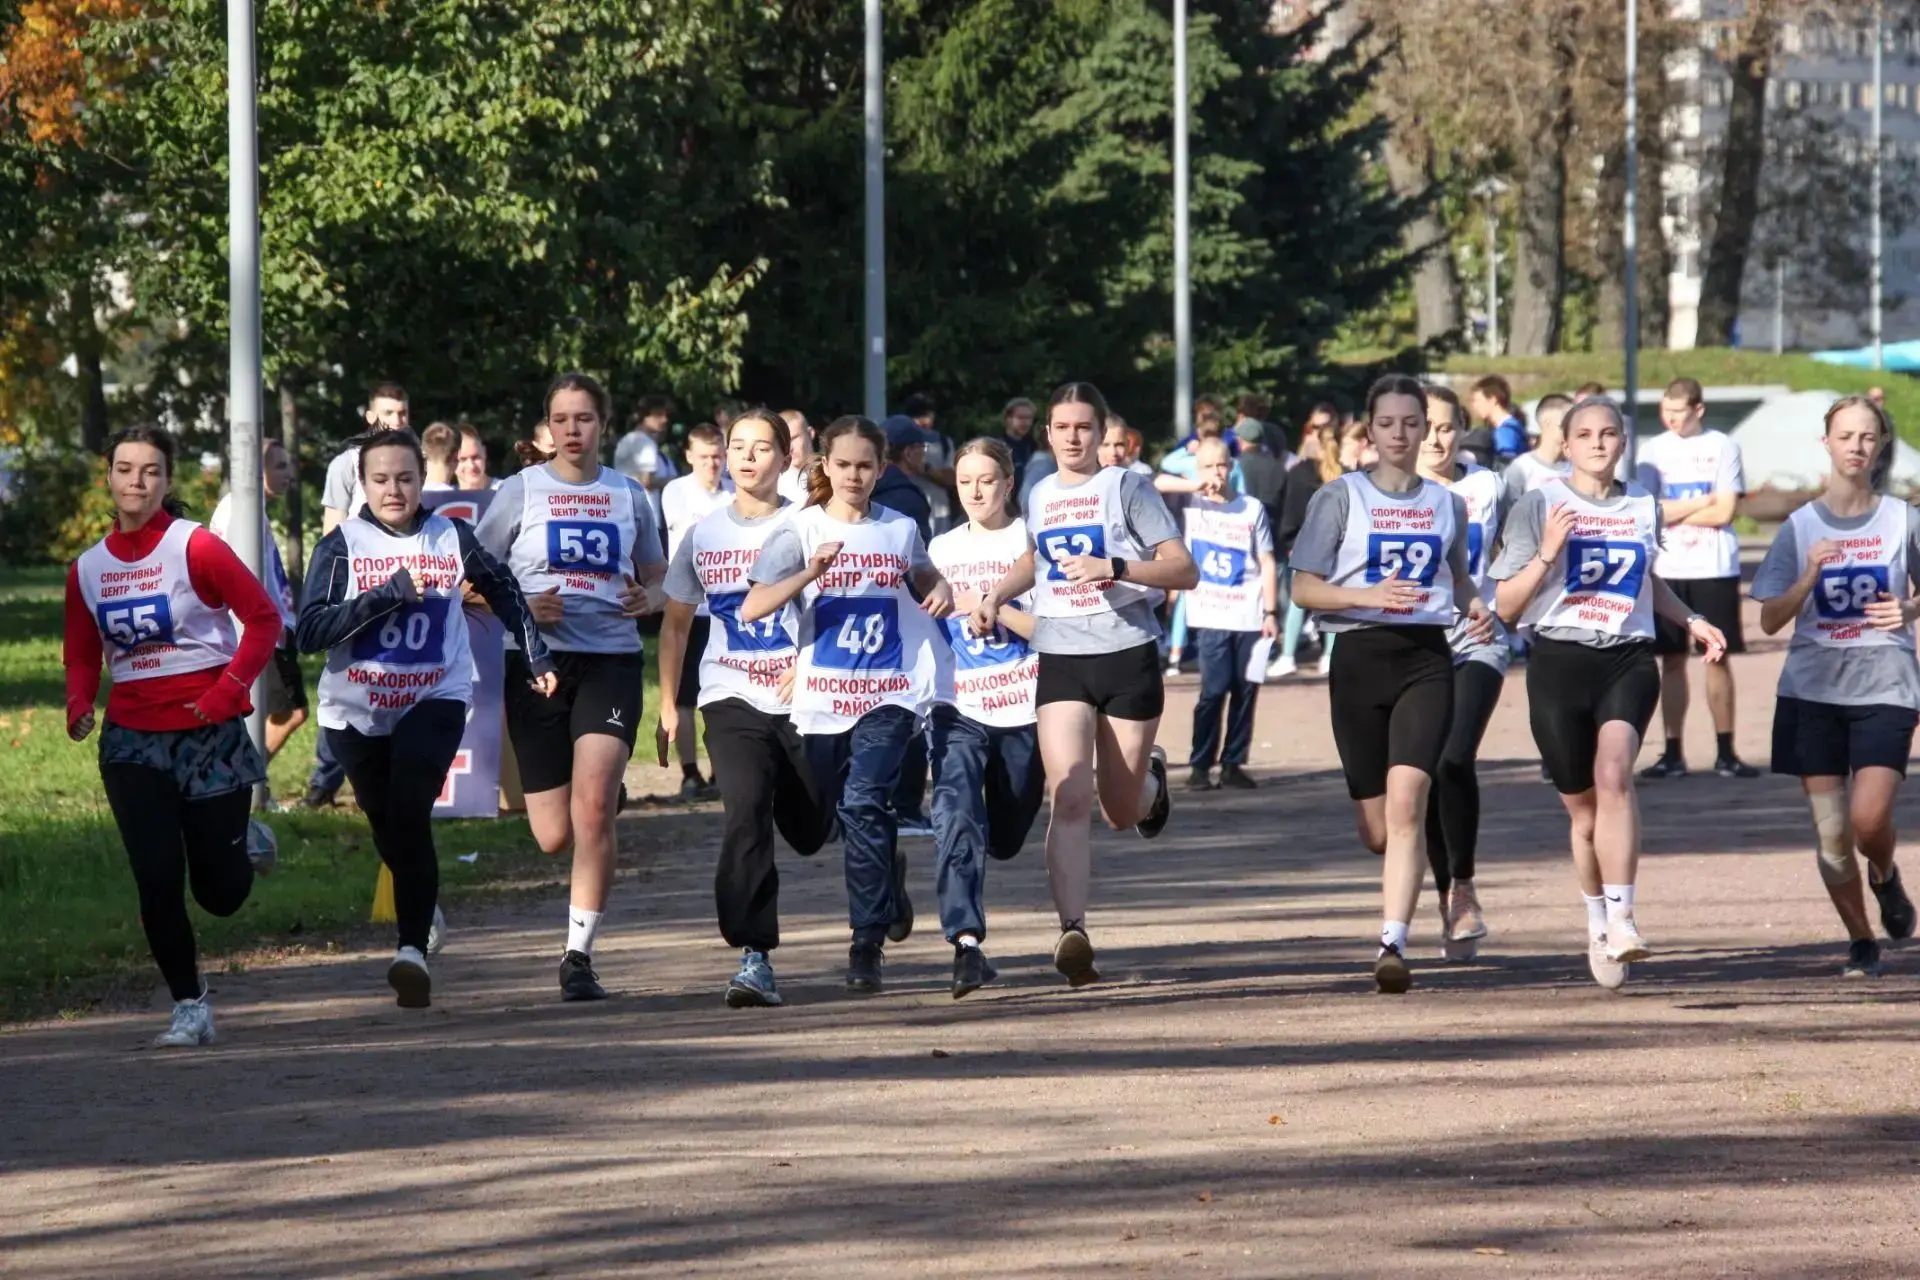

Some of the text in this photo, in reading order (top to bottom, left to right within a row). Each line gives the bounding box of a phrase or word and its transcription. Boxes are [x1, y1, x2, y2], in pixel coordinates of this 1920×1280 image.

[548, 493, 611, 506] СПОРТИВНЫЙ
[1045, 494, 1100, 513] СПОРТИВНЫЙ
[551, 508, 579, 518] ЦЕНТР
[1044, 514, 1067, 526] ЦЕНТР
[1371, 507, 1434, 519] СПОРТИВНЫЙ
[1373, 520, 1401, 530] ЦЕНТР
[559, 527, 610, 566] 53
[353, 554, 458, 574] СПОРТИВНЫЙ
[1380, 541, 1432, 578] 59
[1581, 547, 1636, 586] 57
[100, 562, 163, 583] СПОРТИВНЫЙ
[700, 567, 742, 587] ЦЕНТР
[100, 585, 130, 598] ЦЕНТР
[566, 576, 595, 592] РАЙОН
[1052, 580, 1115, 597] МОСКОВСКИЙ
[1823, 574, 1878, 612] 58
[1070, 595, 1101, 608] РАЙОН
[105, 604, 161, 645] 55
[1579, 608, 1609, 623] РАЙОН
[379, 612, 430, 651] 60
[836, 612, 884, 655] 48
[131, 657, 161, 672] РАЙОН
[348, 668, 445, 689] МОСКОВСКИЙ
[806, 674, 910, 694] МОСКОВСКИЙ
[368, 690, 417, 709] РАЙОН
